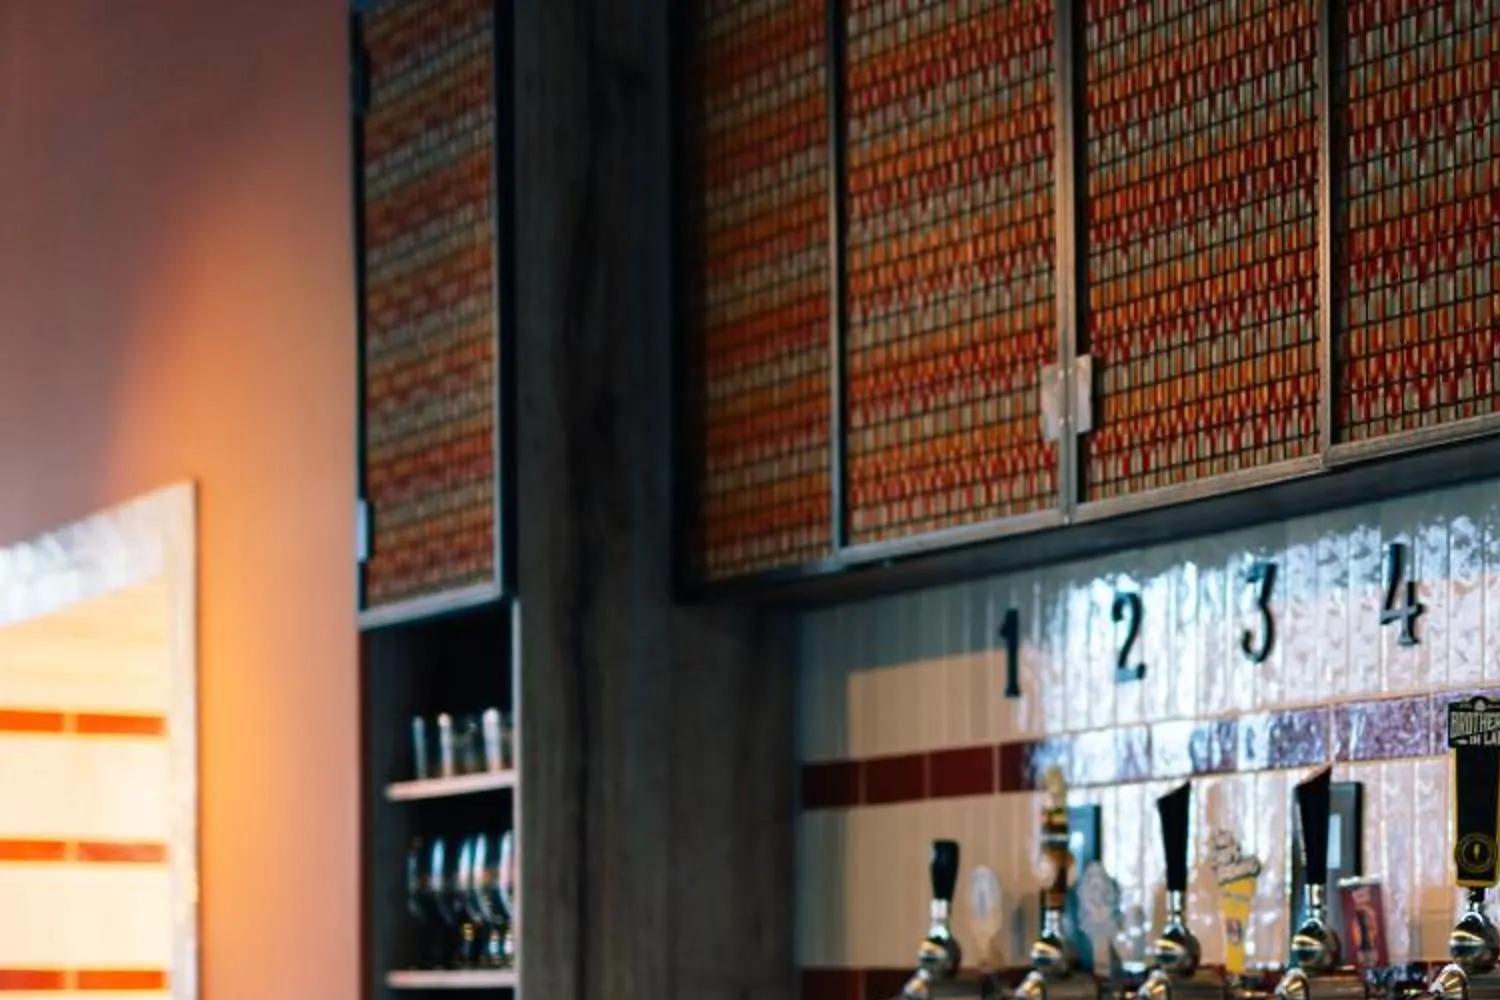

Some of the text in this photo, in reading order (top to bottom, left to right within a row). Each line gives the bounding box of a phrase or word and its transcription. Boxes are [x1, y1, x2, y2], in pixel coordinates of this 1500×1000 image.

[1111, 590, 1147, 683] 2
[1241, 563, 1277, 664] 3
[1379, 543, 1425, 646] 4
[999, 608, 1020, 698] 1
